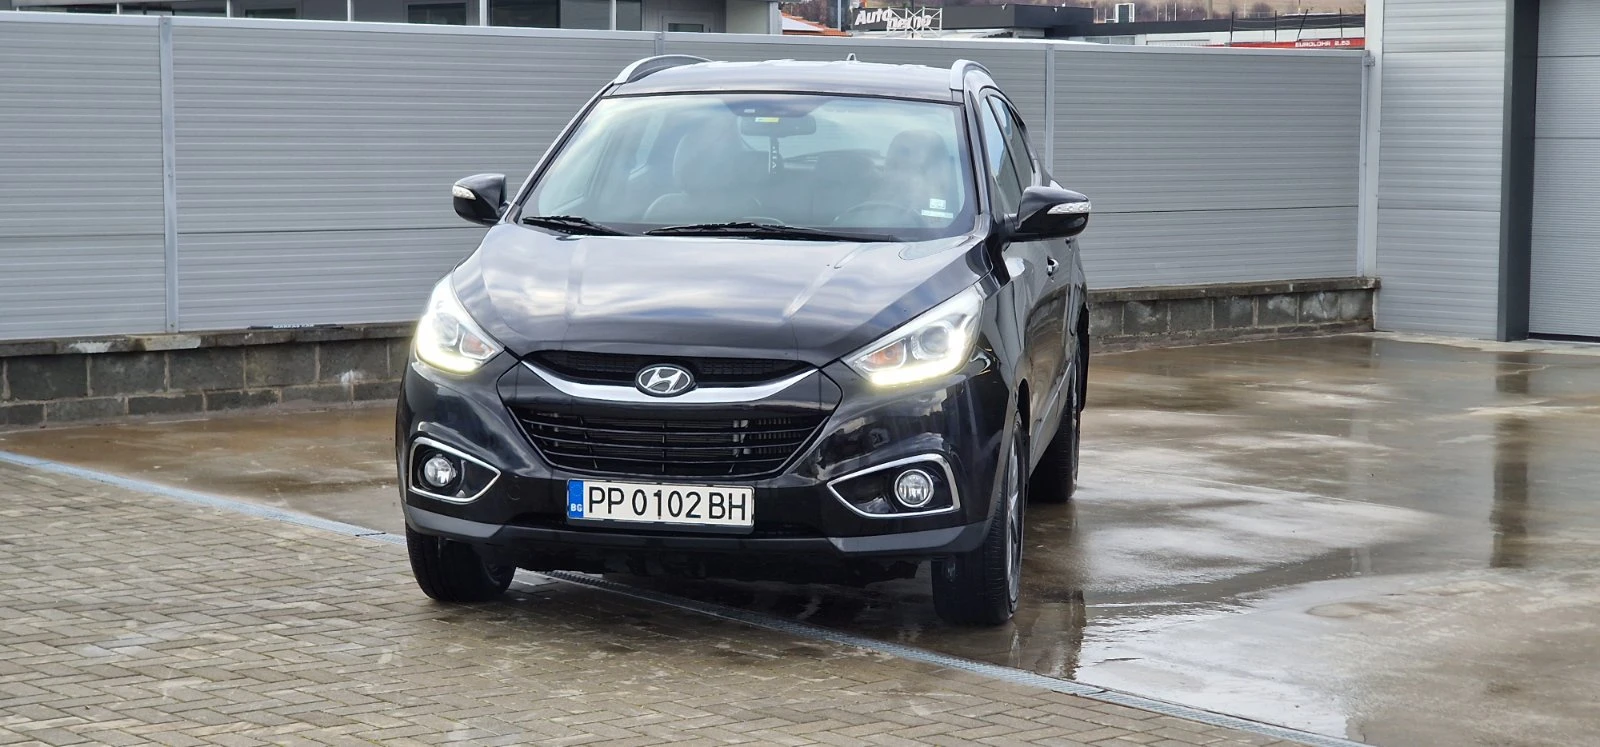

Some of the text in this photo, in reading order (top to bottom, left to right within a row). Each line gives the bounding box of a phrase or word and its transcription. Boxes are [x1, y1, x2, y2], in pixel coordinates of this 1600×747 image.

[854, 9, 892, 26] Auto
[570, 503, 583, 512] BG
[588, 486, 746, 521] PP 0102 BH
